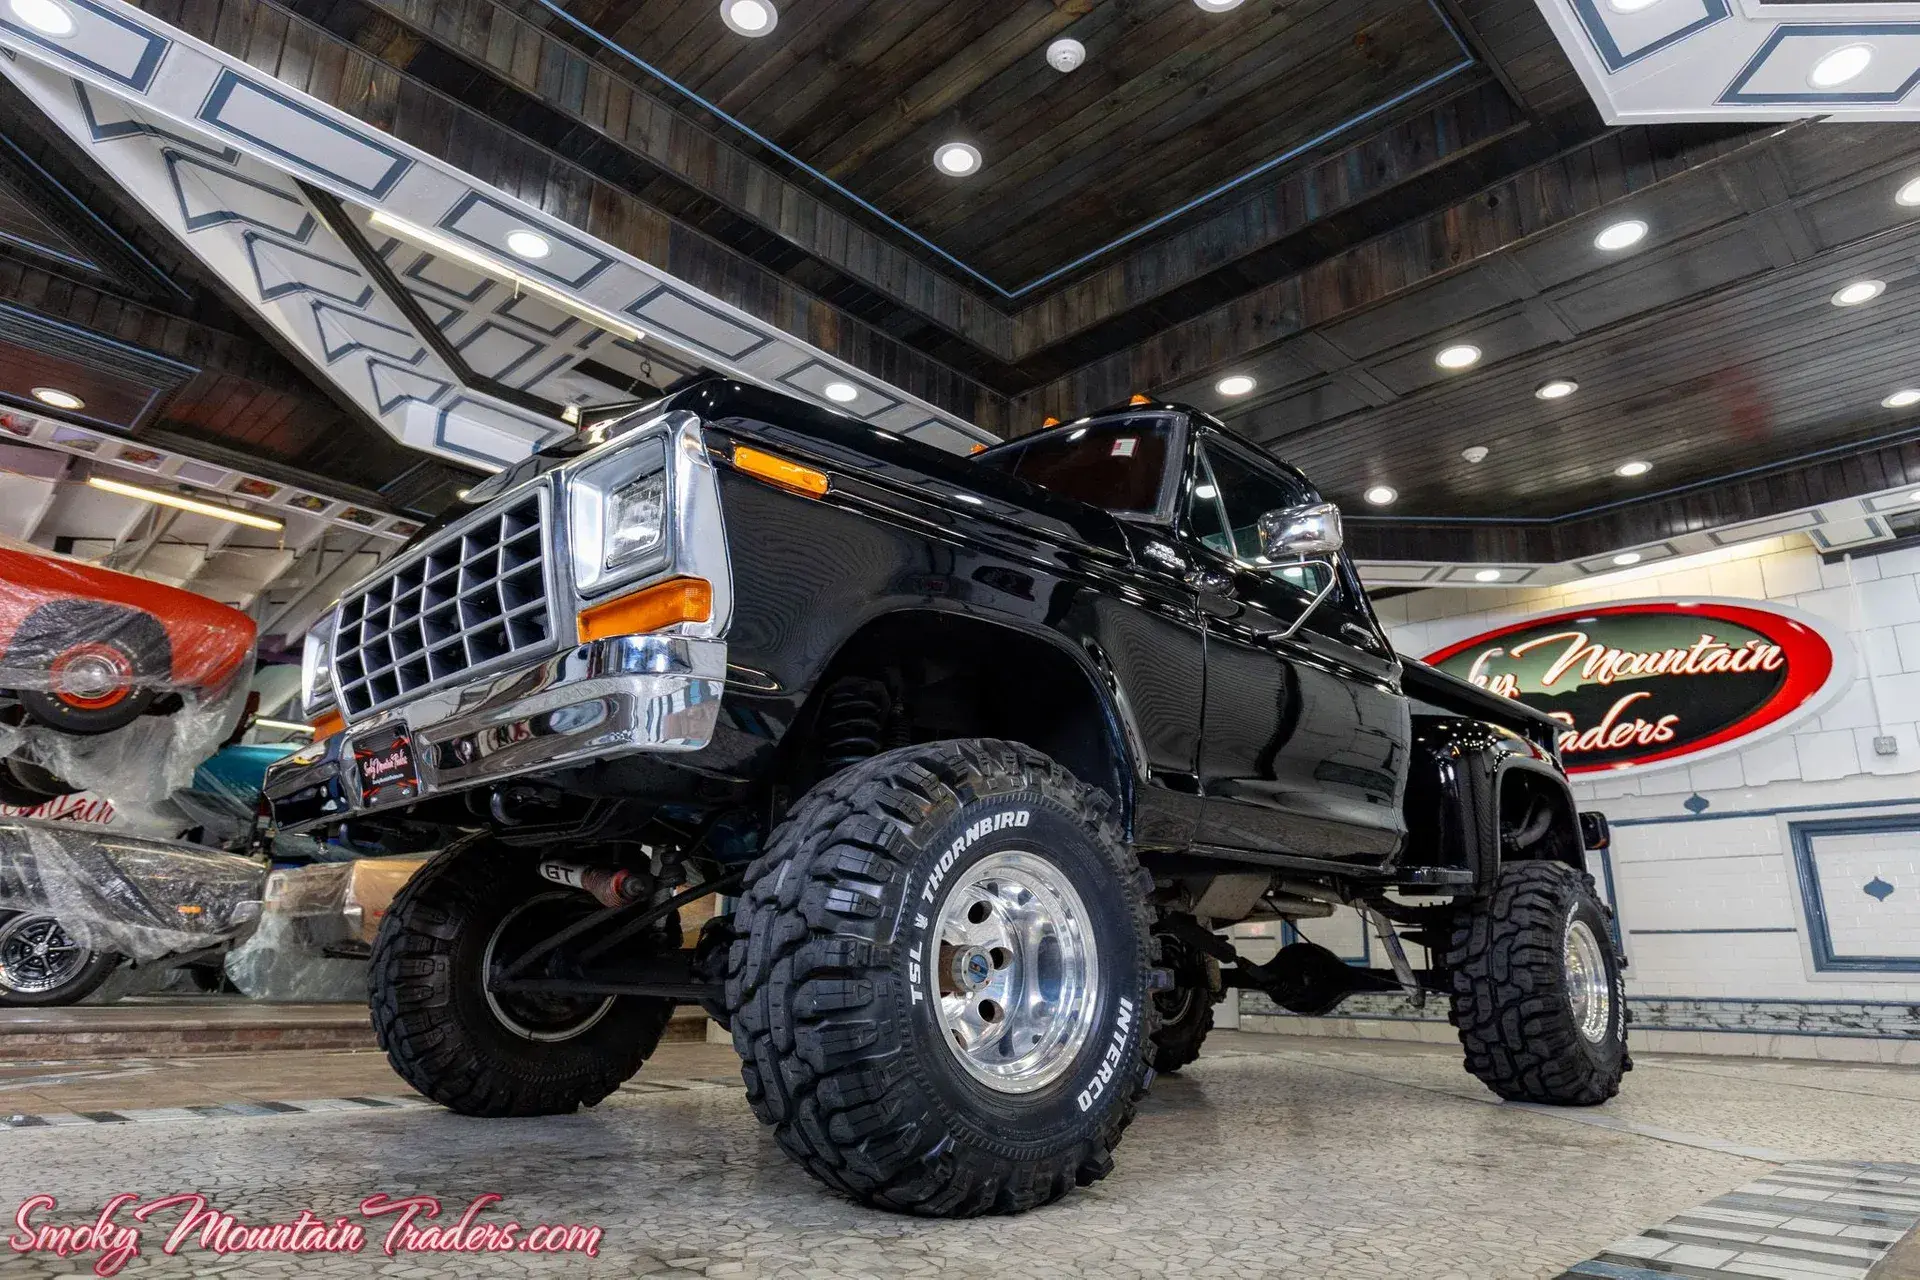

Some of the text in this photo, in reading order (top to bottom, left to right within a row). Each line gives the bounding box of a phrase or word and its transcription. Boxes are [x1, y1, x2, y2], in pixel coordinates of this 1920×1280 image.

[1510, 631, 1785, 686] Mountain
[1547, 691, 1680, 752] aders
[545, 864, 574, 885] GT
[909, 810, 1030, 1006] TSL THORNBIRD
[1077, 996, 1134, 1112] INTERCO
